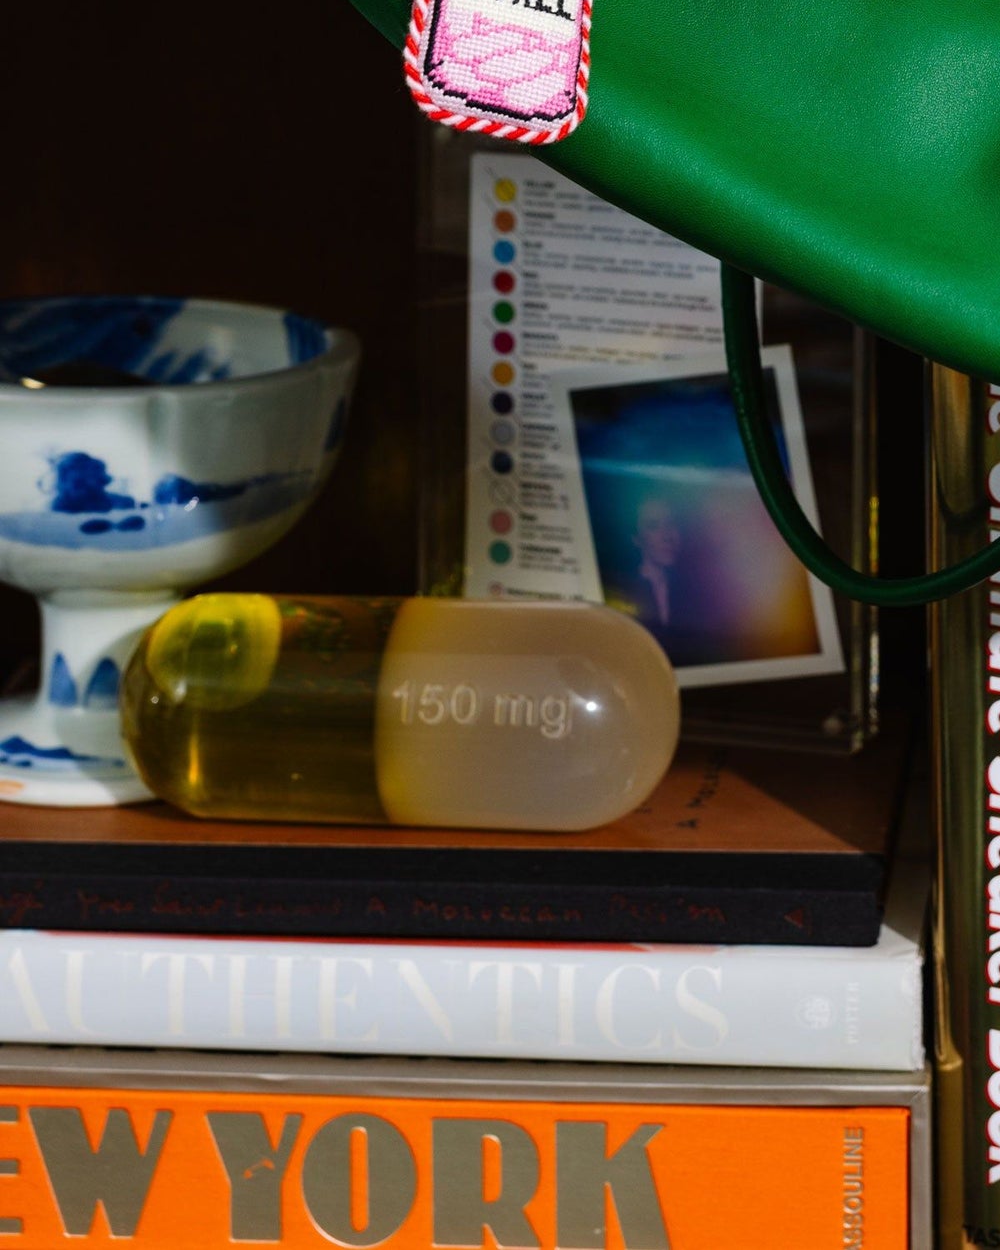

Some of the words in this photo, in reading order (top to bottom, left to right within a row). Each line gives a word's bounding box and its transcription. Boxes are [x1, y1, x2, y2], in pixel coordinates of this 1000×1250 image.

[394, 681, 478, 727] 150
[493, 685, 570, 739] mg
[0, 947, 731, 1053] AUTHENTICS
[205, 1109, 673, 1250] YORK
